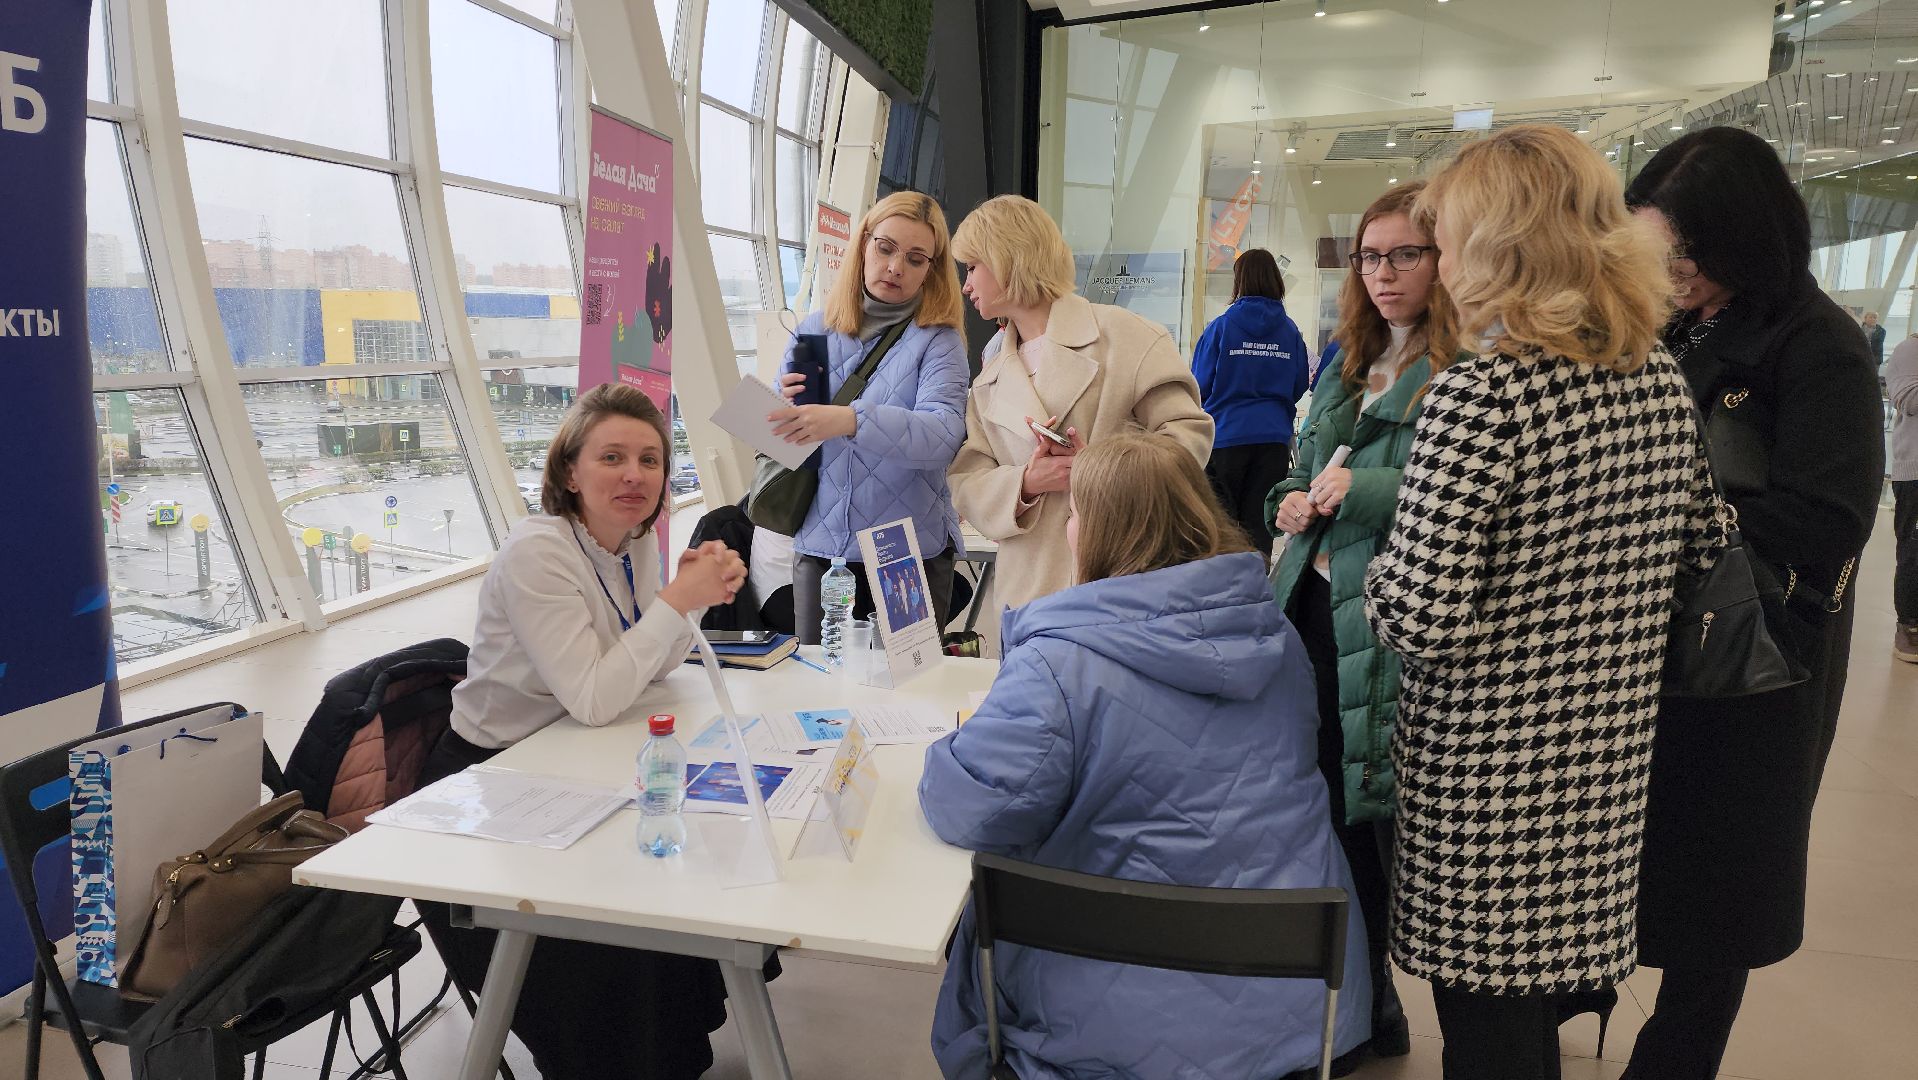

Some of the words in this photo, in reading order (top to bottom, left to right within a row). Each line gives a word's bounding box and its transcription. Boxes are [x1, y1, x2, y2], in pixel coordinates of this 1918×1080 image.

[0, 51, 47, 134] Б
[593, 152, 626, 185] Белая
[628, 165, 656, 194] Дача
[1125, 277, 1155, 285] LEMANS
